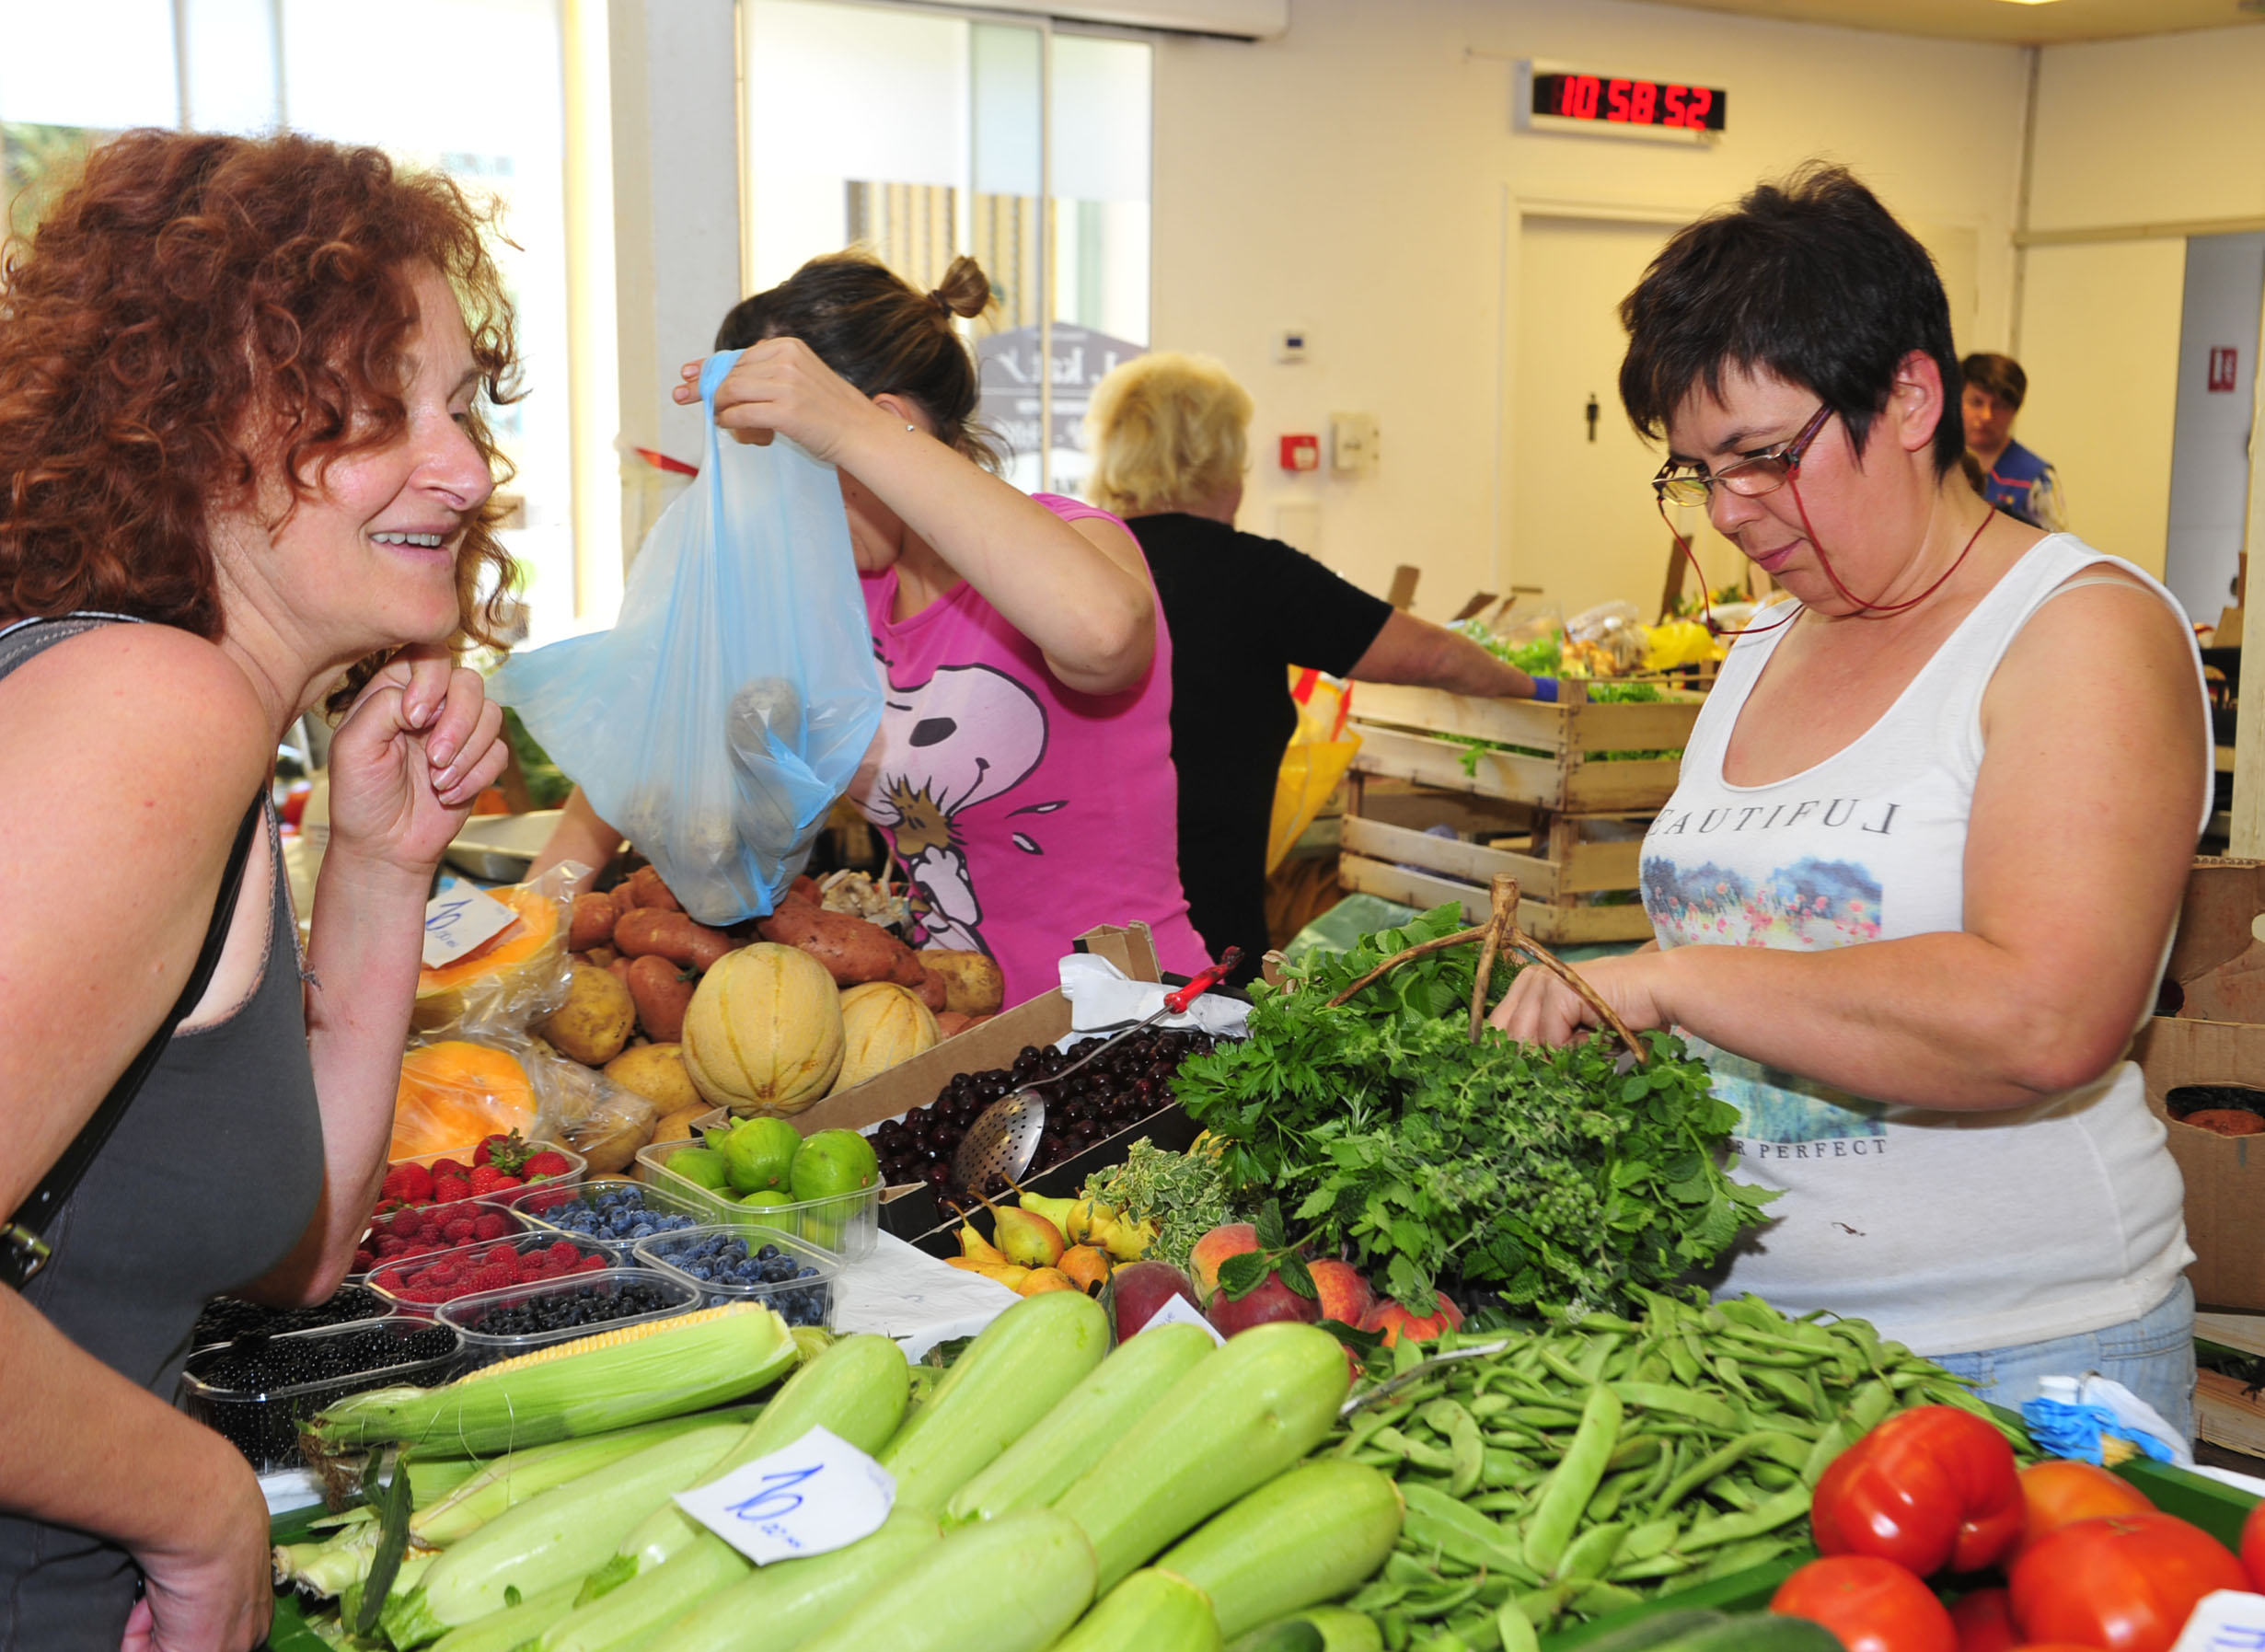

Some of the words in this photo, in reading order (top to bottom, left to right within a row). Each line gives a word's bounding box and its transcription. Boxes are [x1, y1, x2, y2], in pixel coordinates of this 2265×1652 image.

[1561, 74, 1601, 121] 10
[1607, 77, 1657, 126] 58
[1663, 84, 1712, 132] 52
[1647, 798, 1902, 836] EAUTIFUL
[1759, 1138, 1887, 1160] PERFECT
